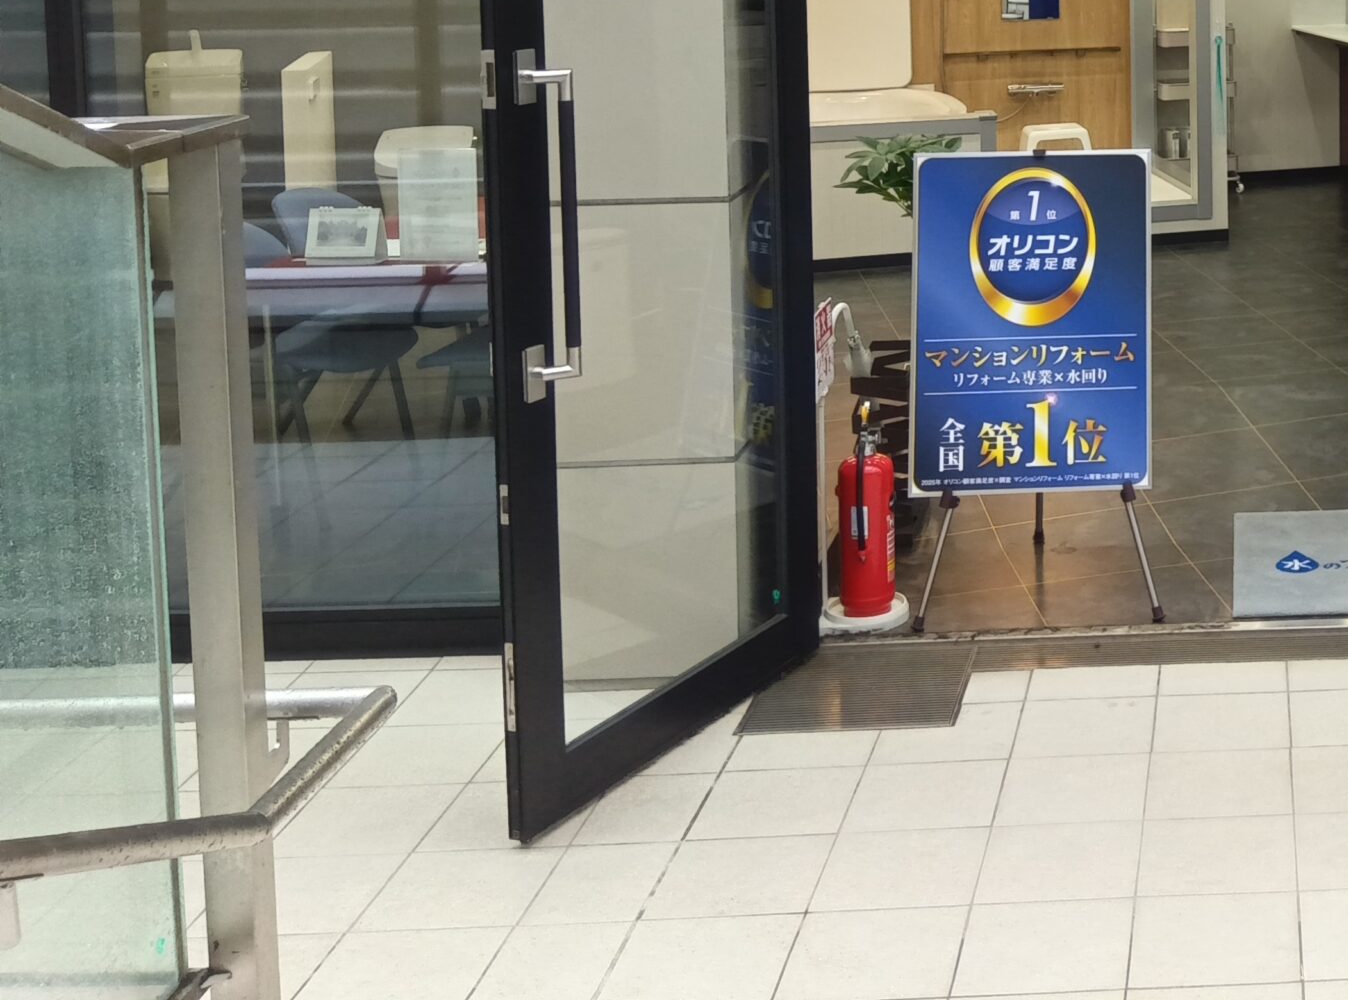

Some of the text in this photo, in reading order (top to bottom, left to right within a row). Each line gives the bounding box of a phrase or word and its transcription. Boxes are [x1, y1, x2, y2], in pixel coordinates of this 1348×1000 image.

[987, 234, 1079, 256] オリコン
[988, 257, 1077, 272] 顧客満足度
[925, 341, 1135, 368] マンションリフォーム
[938, 400, 1108, 472] 全国 第1位
